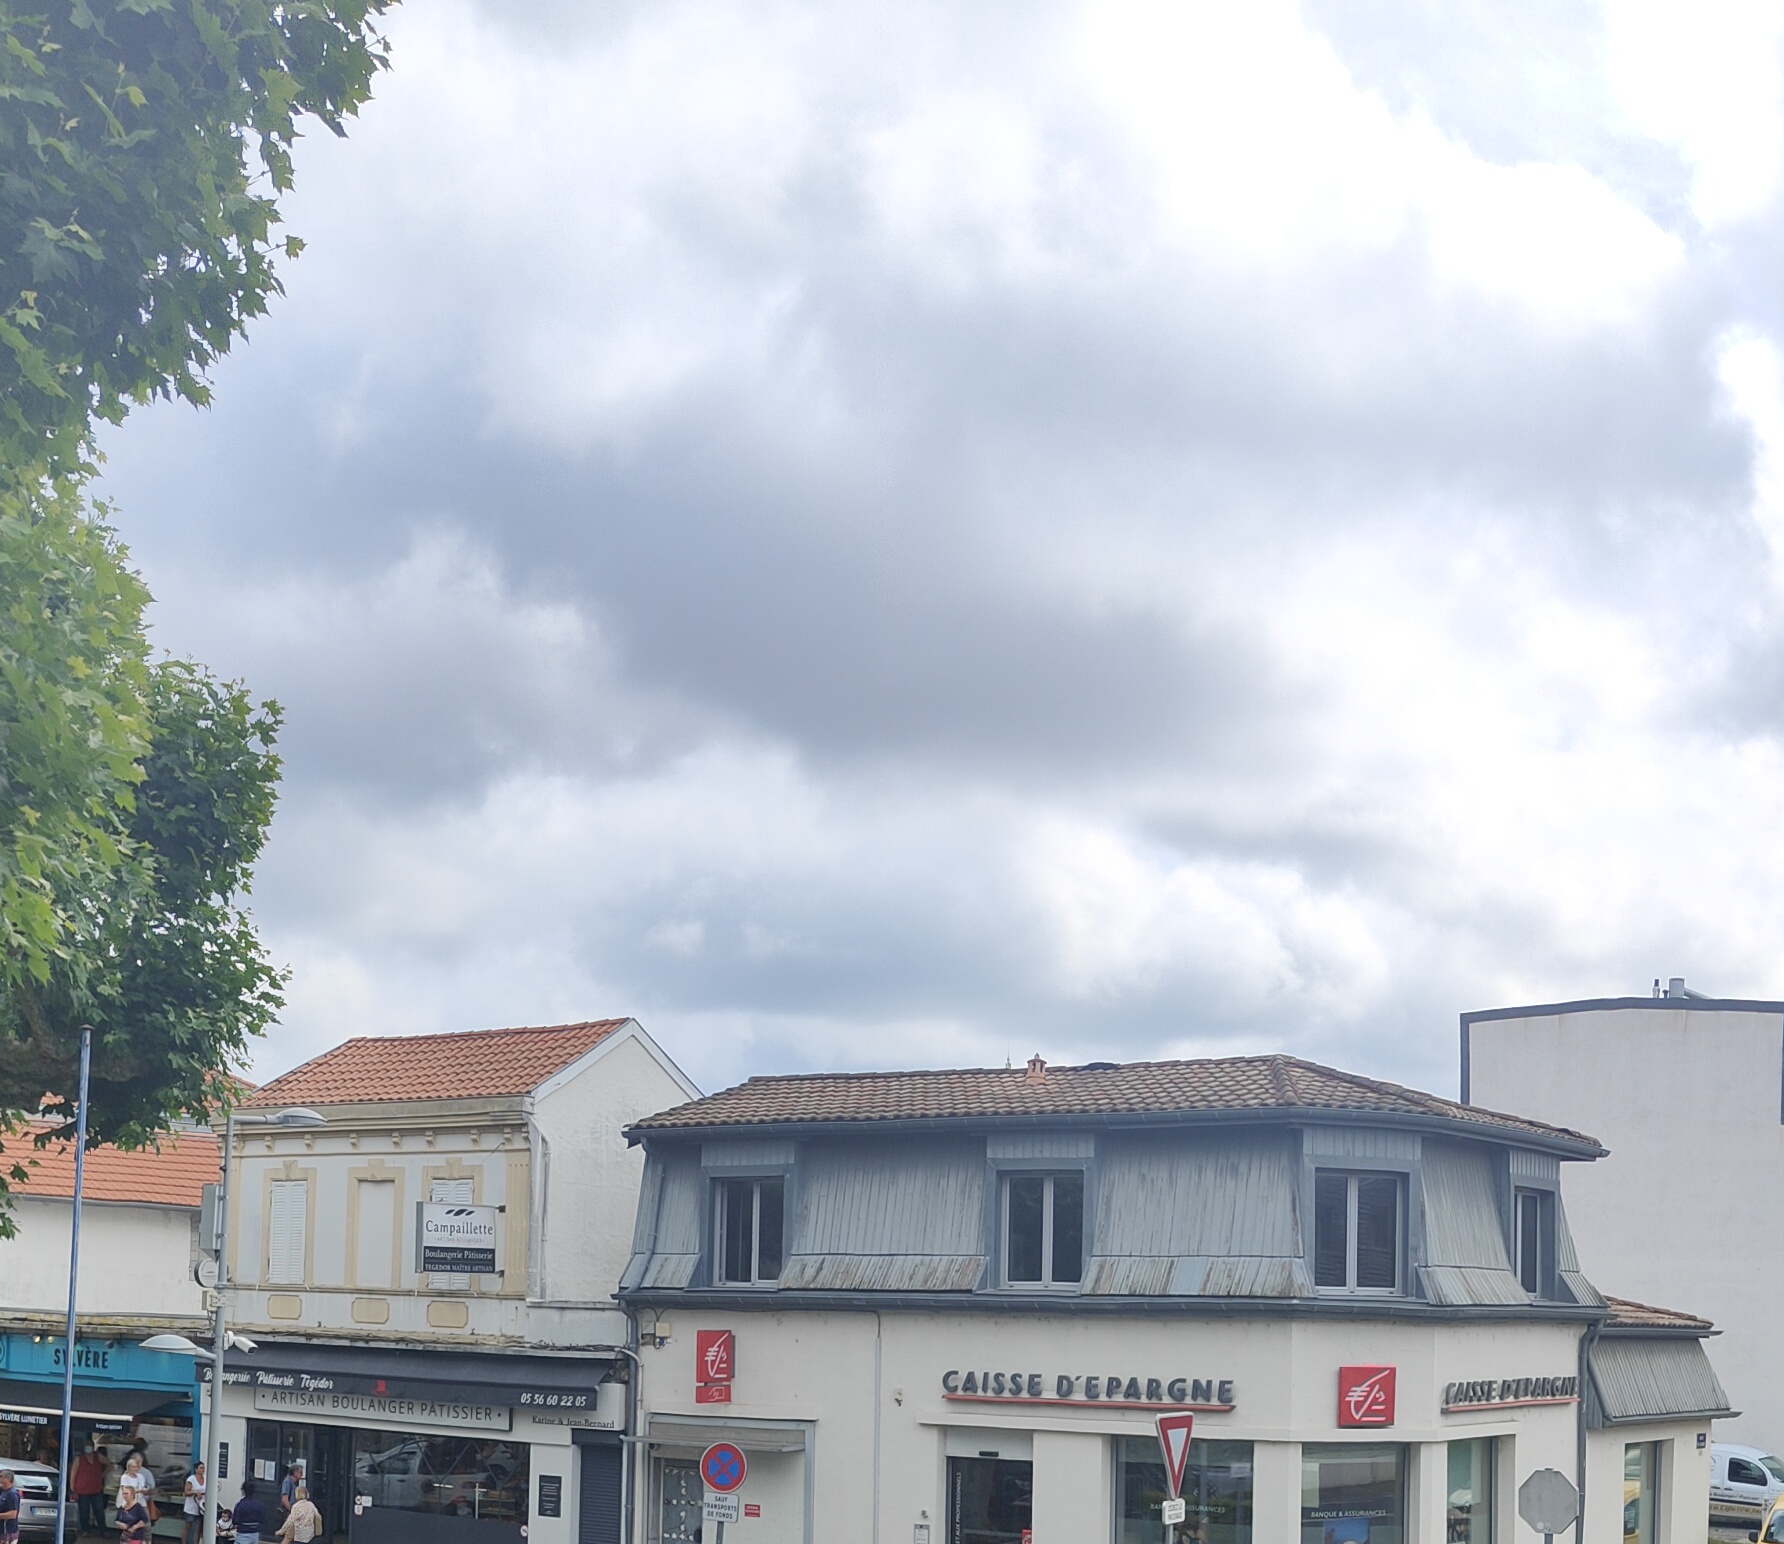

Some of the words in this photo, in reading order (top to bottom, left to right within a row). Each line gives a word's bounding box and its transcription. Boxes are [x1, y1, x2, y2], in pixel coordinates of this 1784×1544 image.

[425, 1220, 493, 1236] Campaillette
[425, 1249, 462, 1260] Boulangerie
[464, 1250, 493, 1260] Pâtisserie
[942, 1370, 1042, 1397] CAISSE
[520, 1392, 532, 1403] 05
[532, 1394, 544, 1405] 56
[546, 1395, 558, 1406] 60
[560, 1396, 573, 1406] 22
[575, 1396, 587, 1407] 05
[1444, 1379, 1498, 1406] CAISSE
[271, 1391, 326, 1407] ARTISAN
[332, 1395, 415, 1415] BOULANGER
[532, 1415, 557, 1425] Karine
[704, 1502, 737, 1512] TRANSPORTS
[715, 1511, 733, 1520] FONDS
